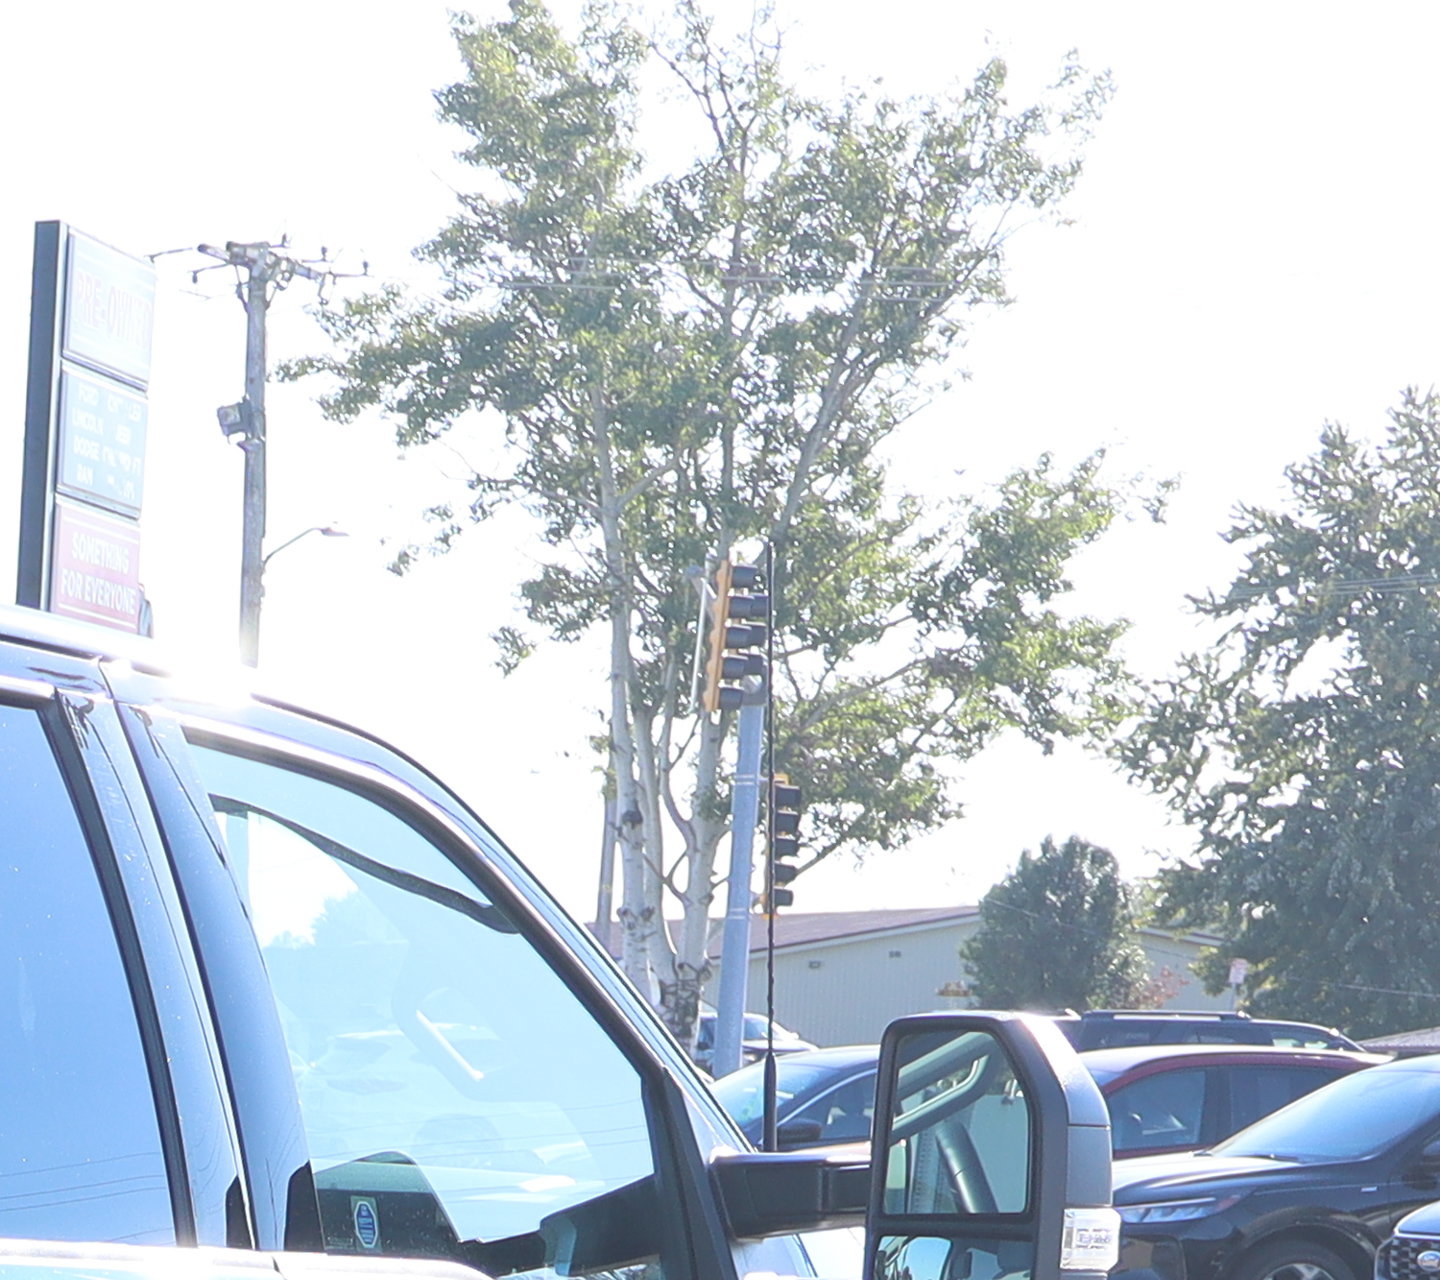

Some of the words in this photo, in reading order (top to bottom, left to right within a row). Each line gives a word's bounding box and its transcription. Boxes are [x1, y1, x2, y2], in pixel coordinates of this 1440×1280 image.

[71, 531, 129, 576] SOMETHING
[61, 567, 83, 600] FOR
[84, 575, 137, 615] EVERYONE
